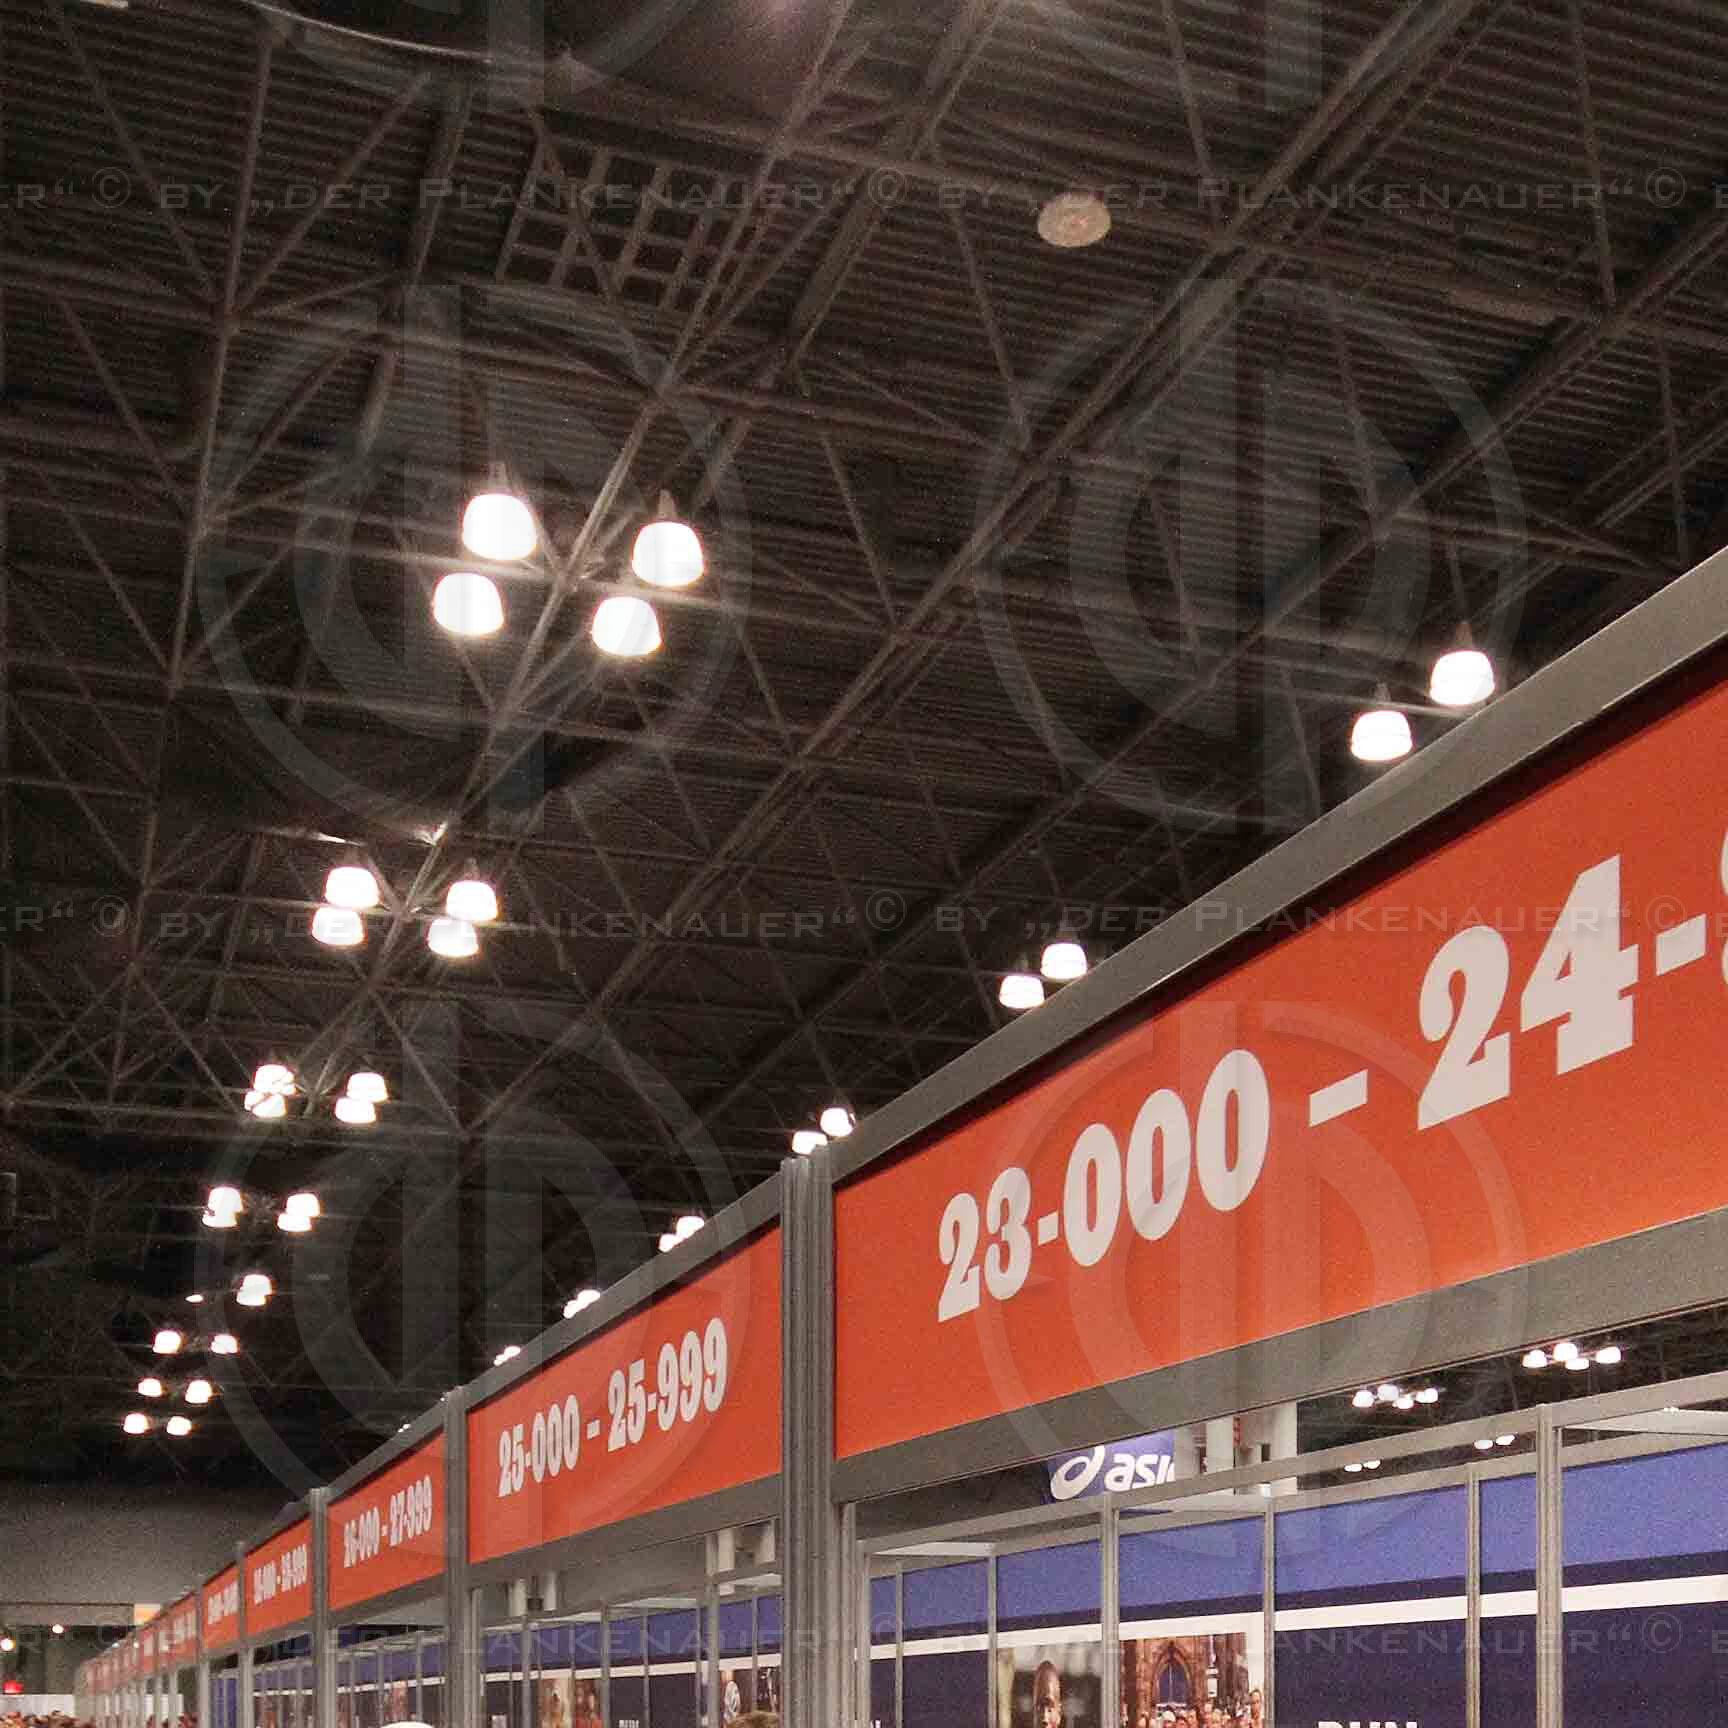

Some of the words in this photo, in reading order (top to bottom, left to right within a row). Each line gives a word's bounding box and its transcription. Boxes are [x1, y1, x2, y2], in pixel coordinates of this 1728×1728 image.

[938, 1049, 1270, 1322] 23-000
[498, 1395, 580, 1497] 25-000
[608, 1317, 728, 1452] 25-999
[1104, 1453, 1176, 1492] asi
